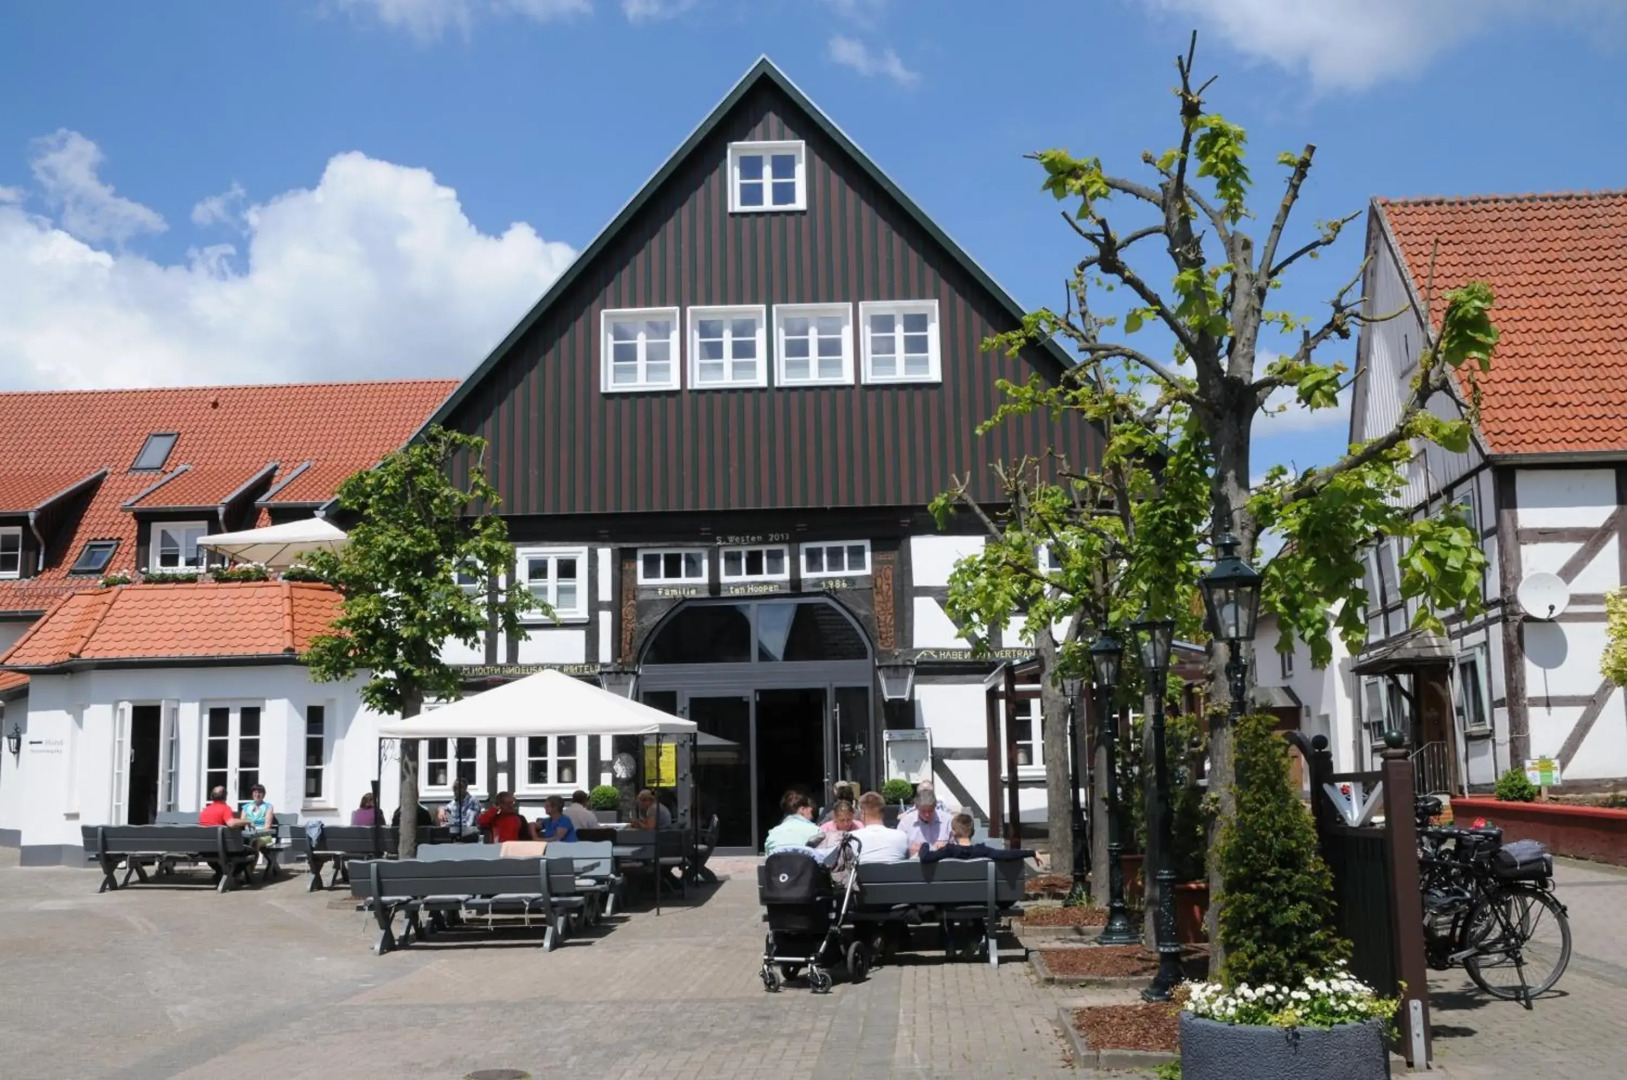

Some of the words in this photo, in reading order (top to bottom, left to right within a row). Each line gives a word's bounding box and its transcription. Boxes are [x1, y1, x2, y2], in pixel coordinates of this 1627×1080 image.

[768, 532, 790, 542] 2013
[820, 579, 848, 589] 1986
[657, 587, 697, 596] Familie
[939, 650, 972, 660] HABEN
